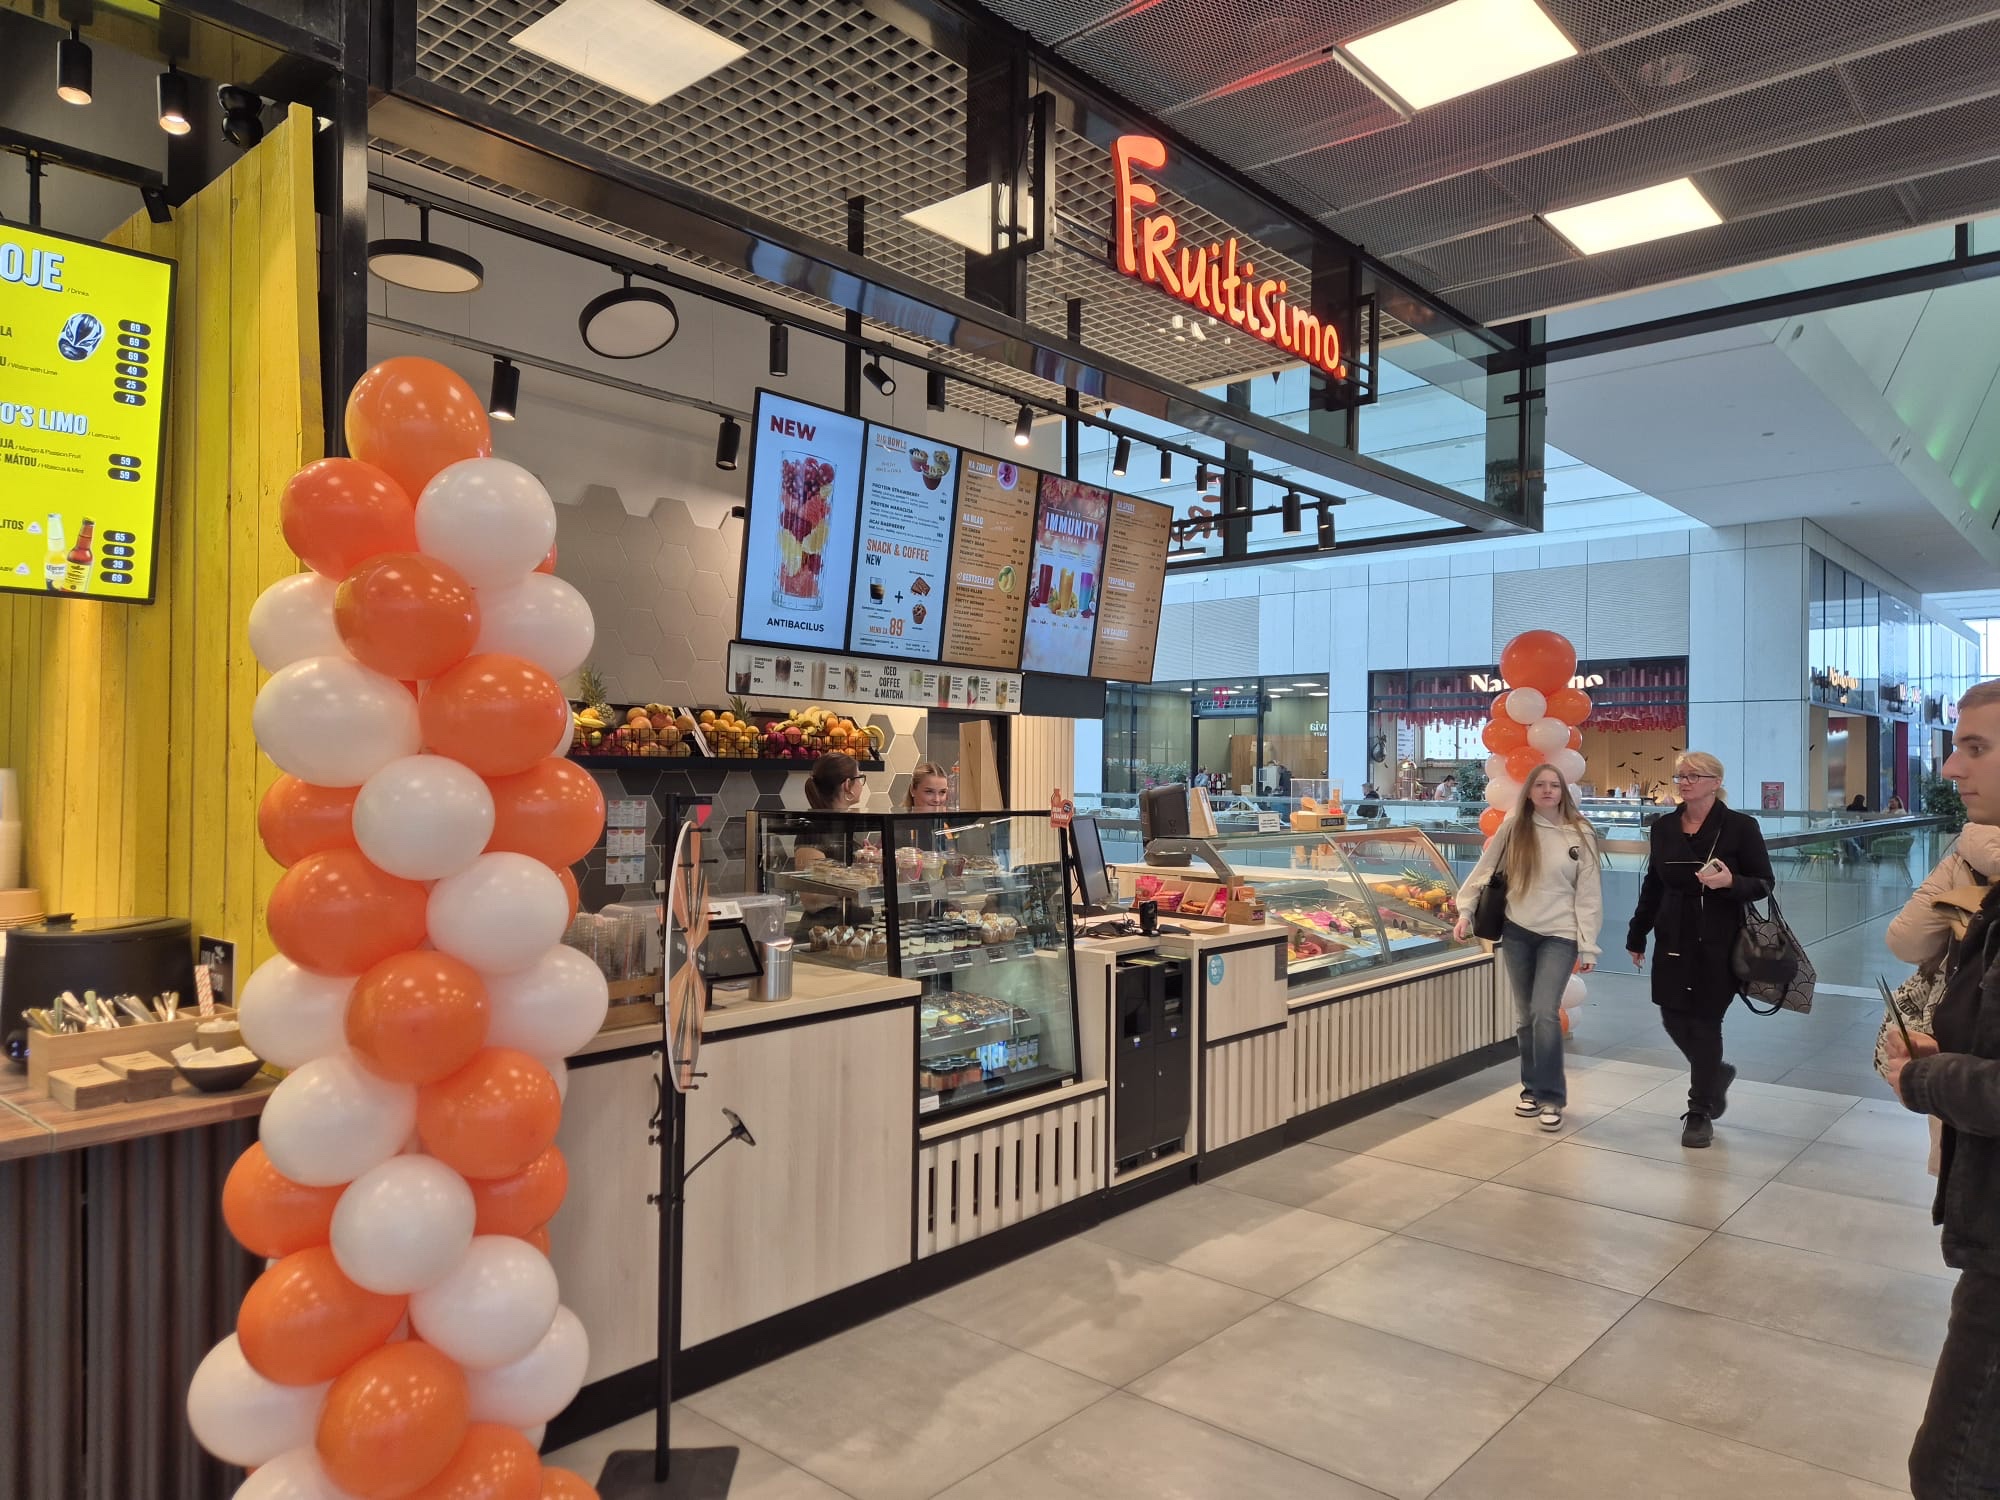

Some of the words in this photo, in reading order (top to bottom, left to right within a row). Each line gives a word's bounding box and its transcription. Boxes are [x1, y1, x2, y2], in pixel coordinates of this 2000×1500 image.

[0, 242, 65, 292] OJE
[128, 351, 138, 361] 69
[127, 366, 138, 375] 49
[126, 380, 137, 390] 25
[125, 394, 136, 404] 75
[0, 402, 35, 428] O'S
[38, 408, 88, 436] LIMO
[770, 415, 817, 442] NEW
[4, 453, 38, 467] MÁTOU
[120, 456, 131, 466] 59
[119, 470, 130, 480] 59
[0, 519, 24, 531] ITOS
[1045, 511, 1099, 541] IMMUNITY
[115, 532, 125, 542] 65
[866, 538, 892, 555] SNACK
[894, 544, 901, 556] &
[902, 545, 930, 562] COFFEE
[112, 559, 123, 569] 39
[865, 553, 882, 567] NEW
[111, 573, 122, 582] 69
[766, 617, 825, 632] ANTIBACILUS
[883, 665, 897, 677] ICED
[878, 675, 902, 688] COFFEE
[874, 688, 879, 698] &
[879, 688, 904, 700] MATCHA
